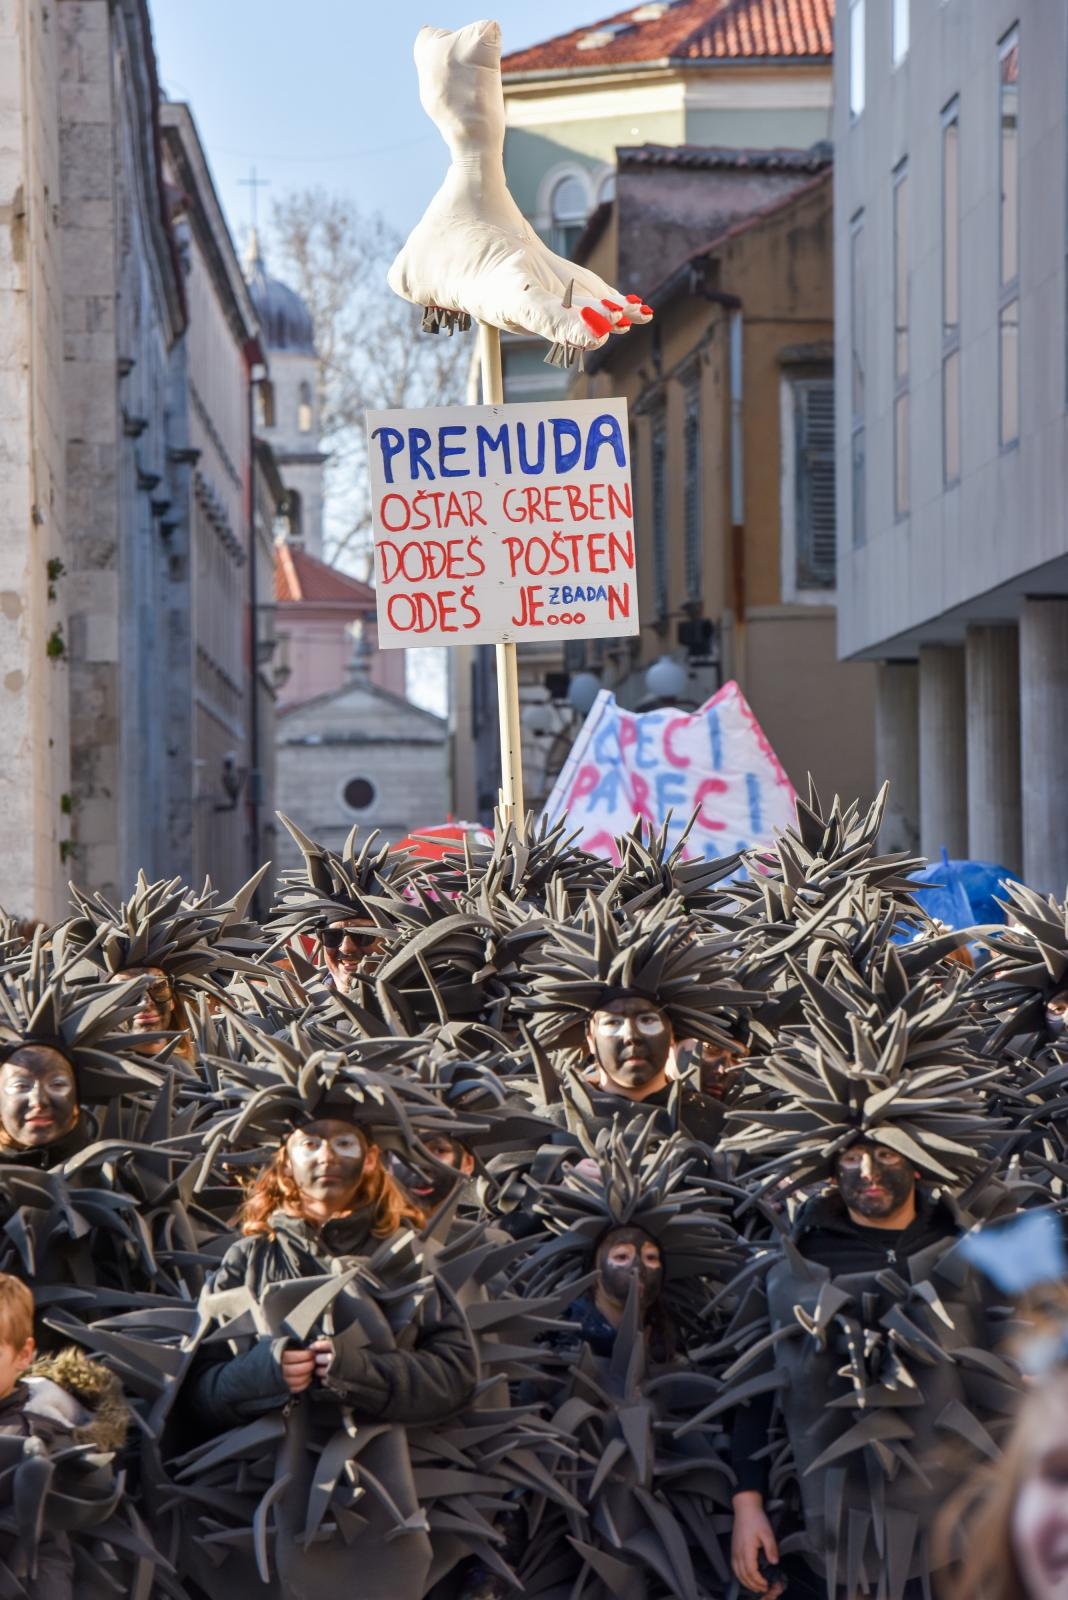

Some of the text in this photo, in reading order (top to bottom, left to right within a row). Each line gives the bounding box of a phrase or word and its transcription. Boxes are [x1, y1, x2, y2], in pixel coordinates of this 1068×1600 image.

[371, 414, 627, 483] PREMUDA
[380, 483, 633, 532] OŠTAR GREBEN
[375, 530, 634, 584] DOĐEŠ POŠTEN
[387, 585, 481, 633] ODEŠ
